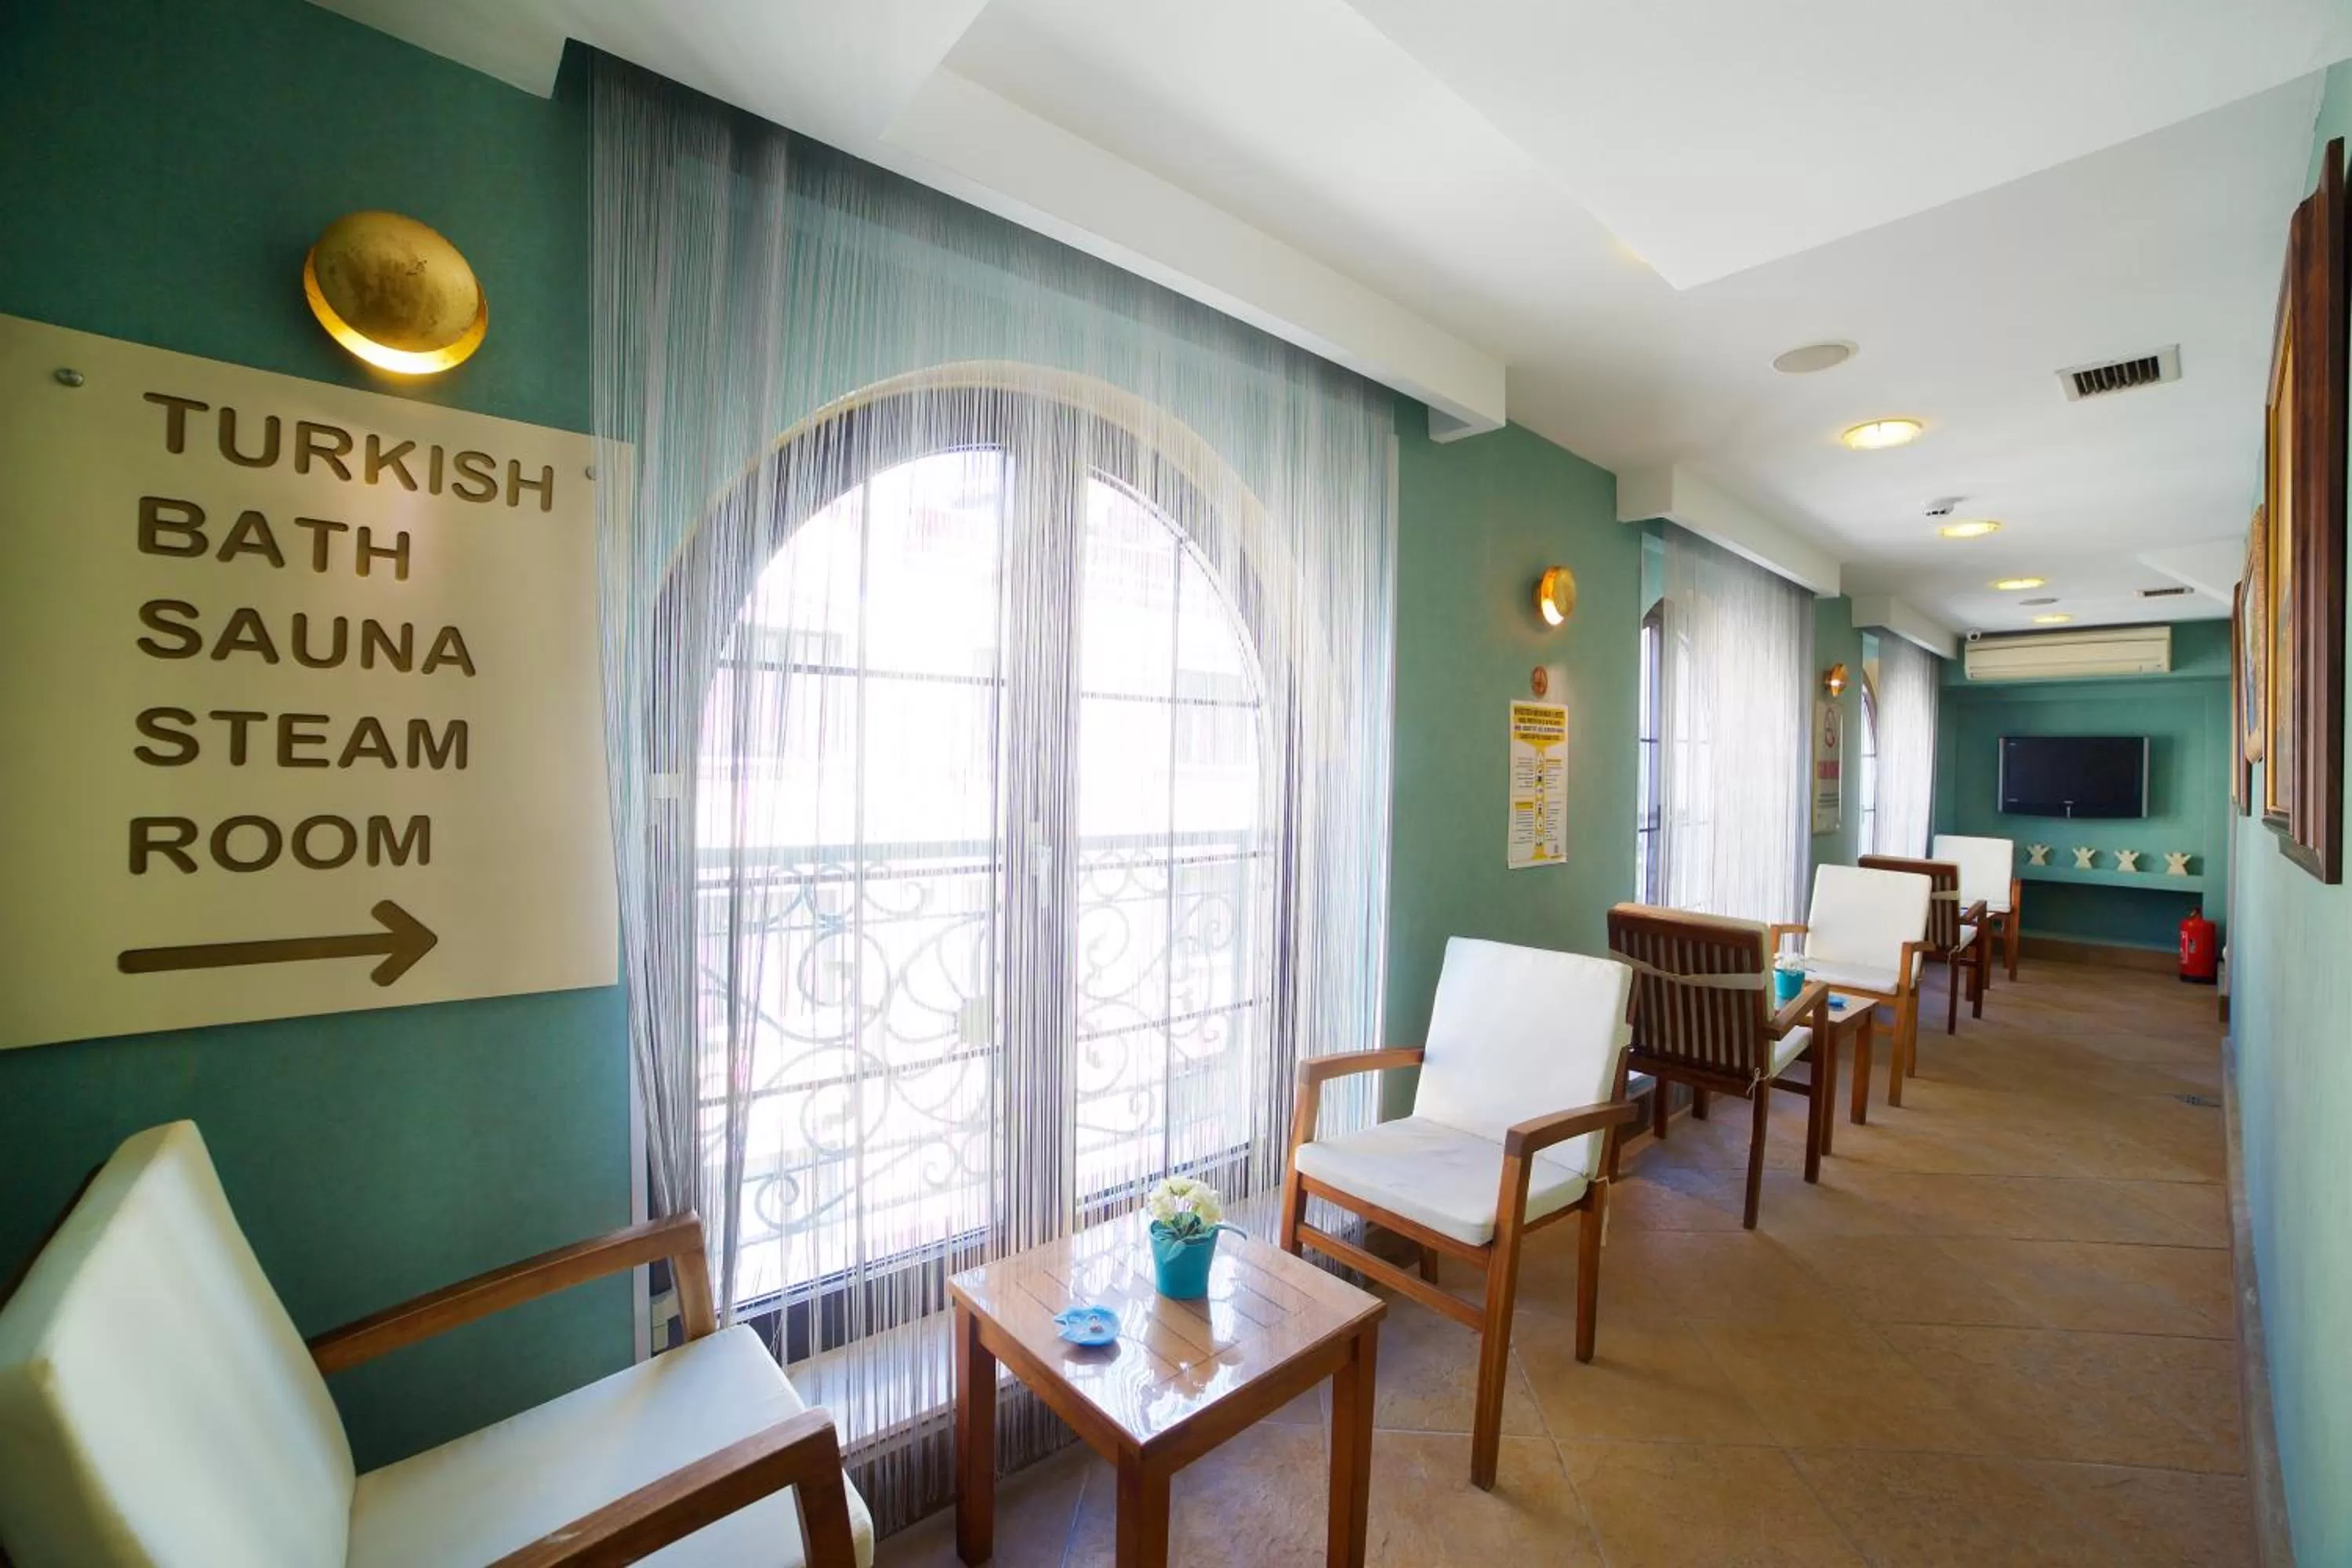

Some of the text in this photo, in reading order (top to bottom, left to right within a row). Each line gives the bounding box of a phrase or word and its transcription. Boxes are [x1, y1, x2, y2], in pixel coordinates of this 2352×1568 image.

[143, 391, 554, 513] TURKISH
[137, 495, 411, 581] BATH
[136, 598, 477, 678] SAUNA
[132, 706, 469, 771] STEAM
[128, 815, 431, 876] ROOM
